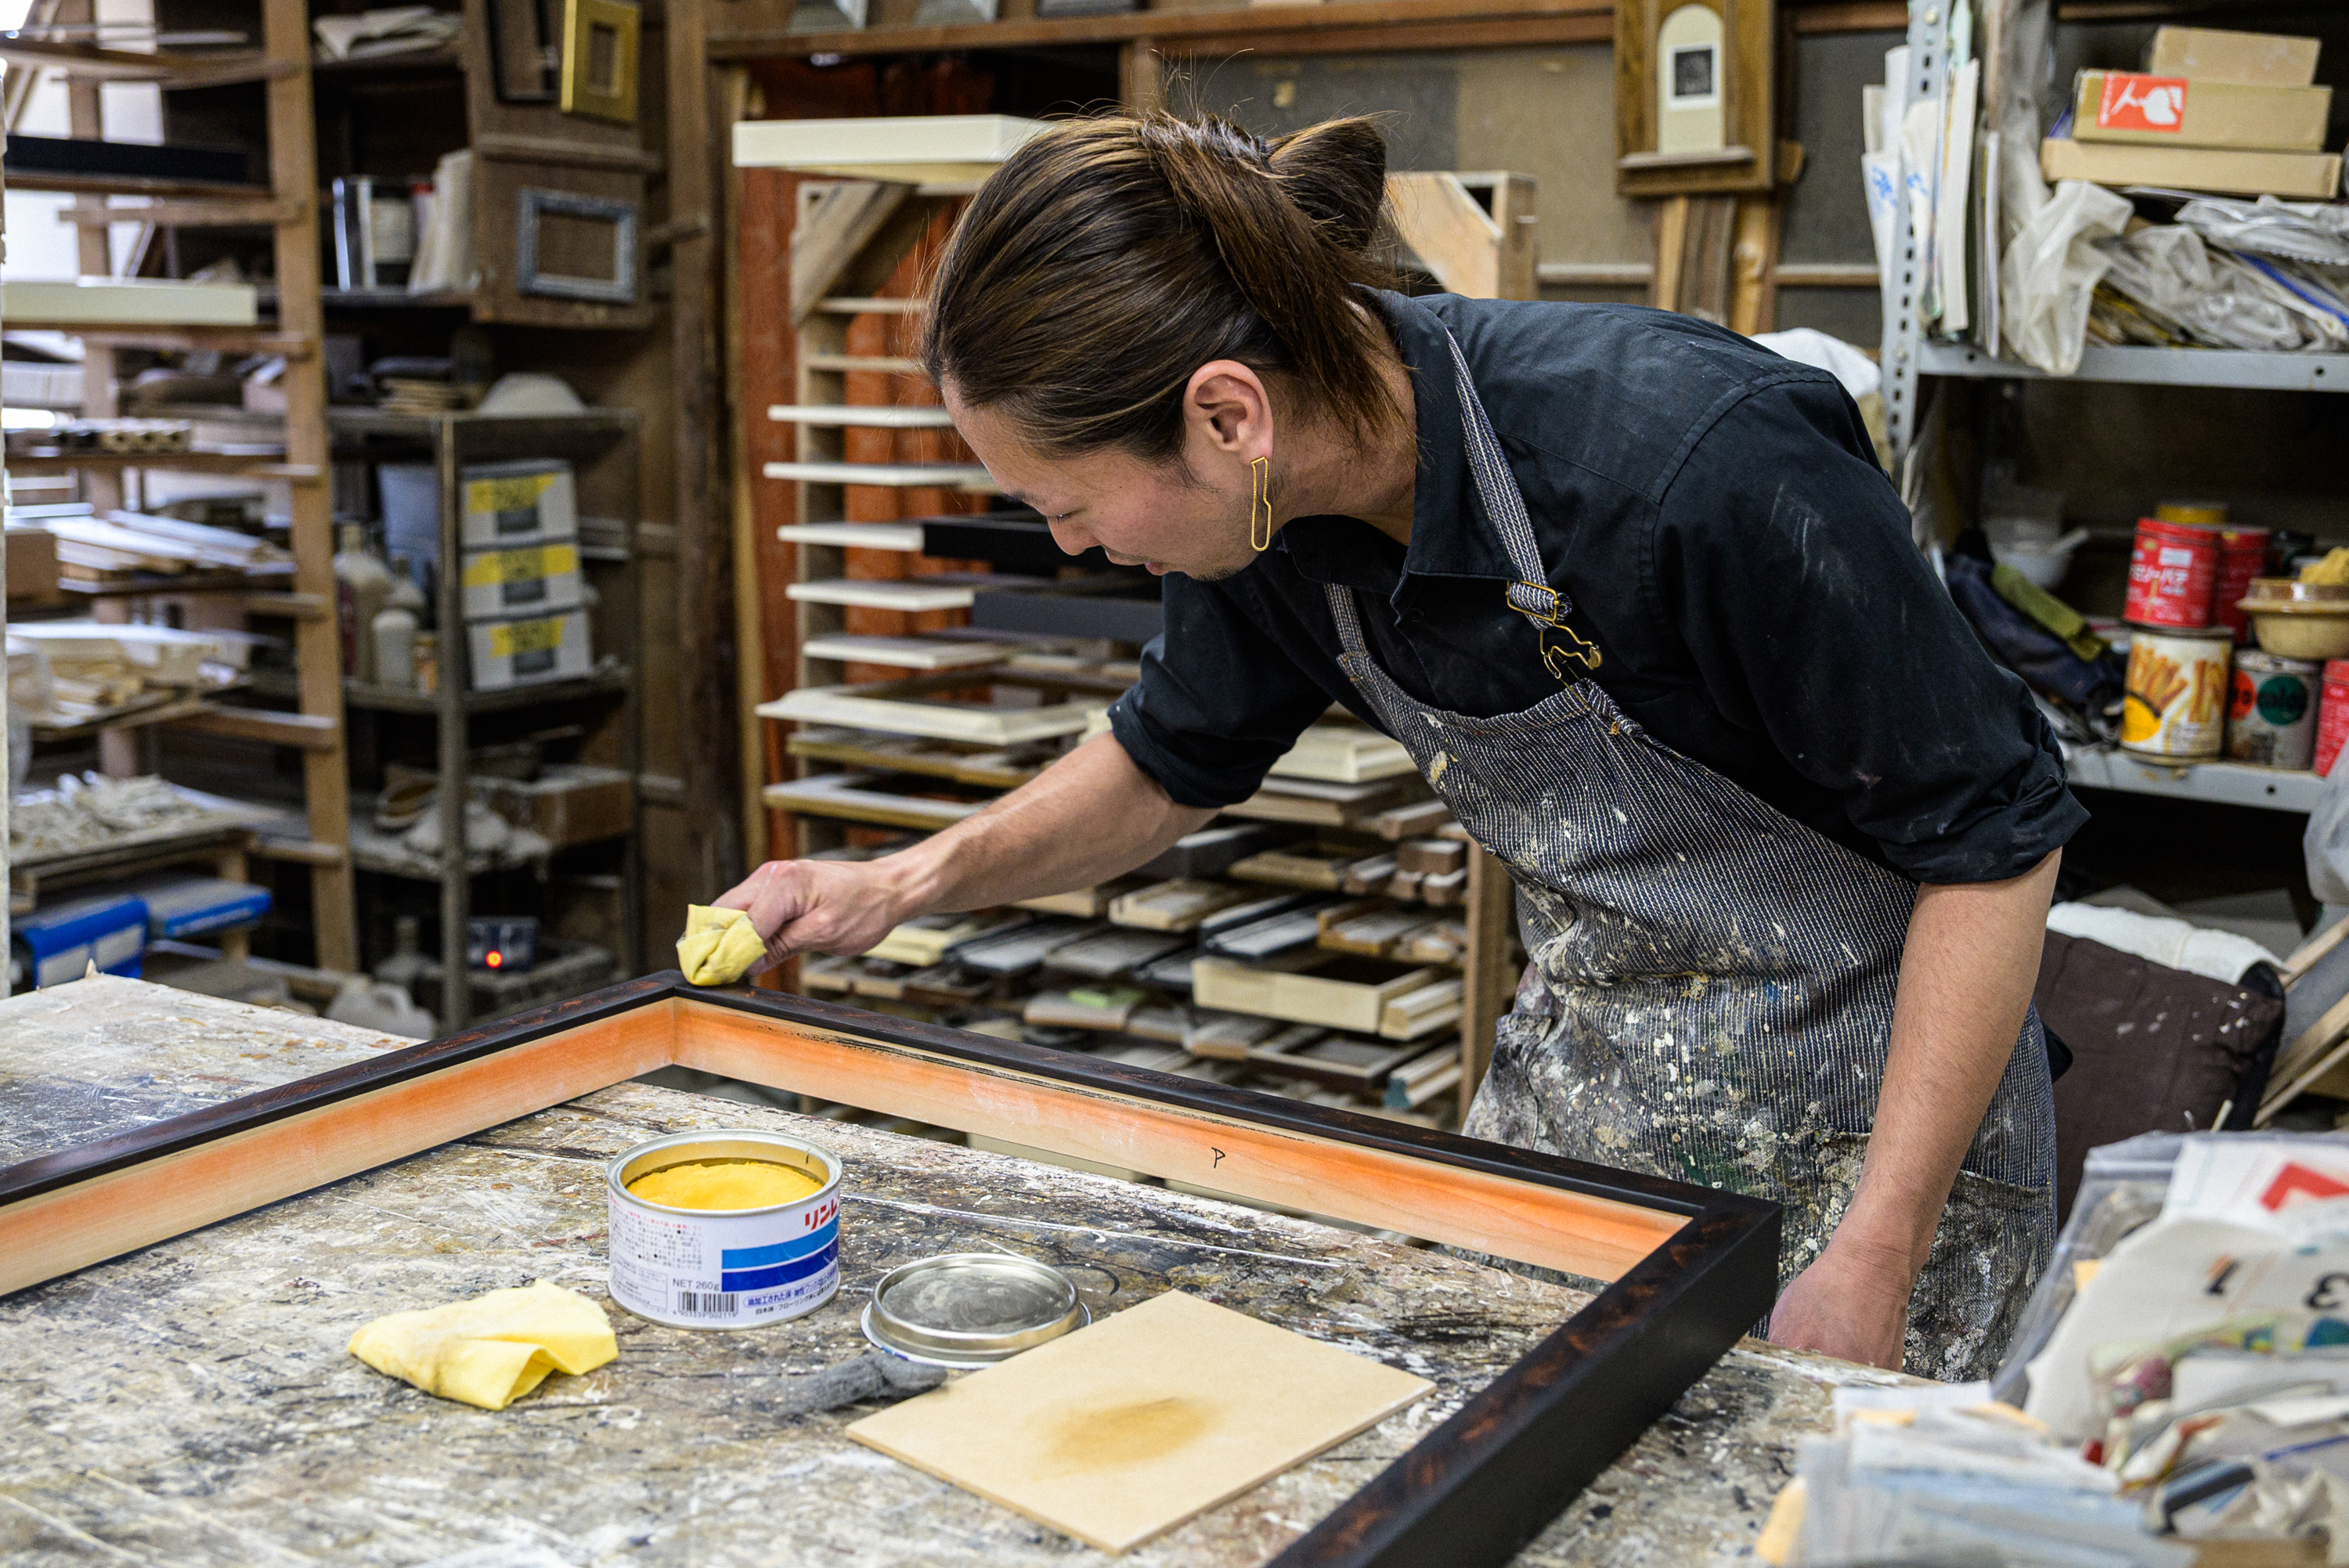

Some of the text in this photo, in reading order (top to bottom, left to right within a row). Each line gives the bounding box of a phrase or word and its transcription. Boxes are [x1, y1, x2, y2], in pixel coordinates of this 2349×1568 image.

[1211, 1147, 1225, 1169] P
[673, 1278, 720, 1292] NET 260g
